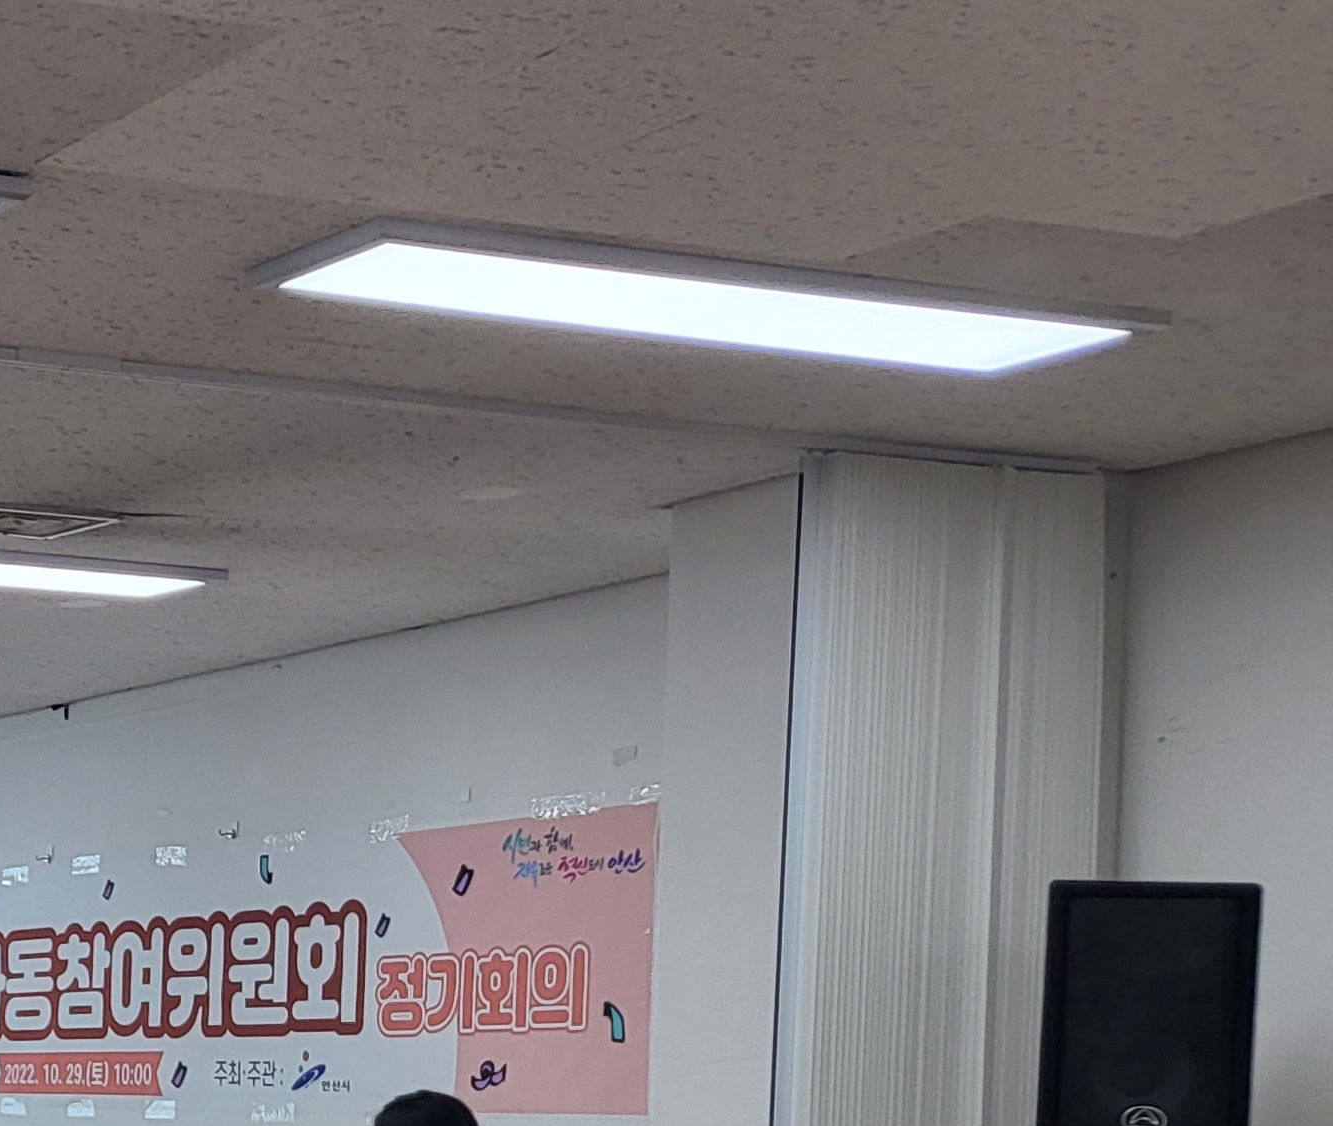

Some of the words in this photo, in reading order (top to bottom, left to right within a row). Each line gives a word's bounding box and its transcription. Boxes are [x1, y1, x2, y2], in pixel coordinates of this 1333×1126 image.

[607, 848, 646, 874] 안산
[377, 943, 588, 1035] 정기회의
[4, 1063, 39, 1085] 2022.
[43, 1063, 62, 1085] 10.
[114, 1062, 152, 1085] 10:00
[321, 1080, 351, 1092] 안산시
